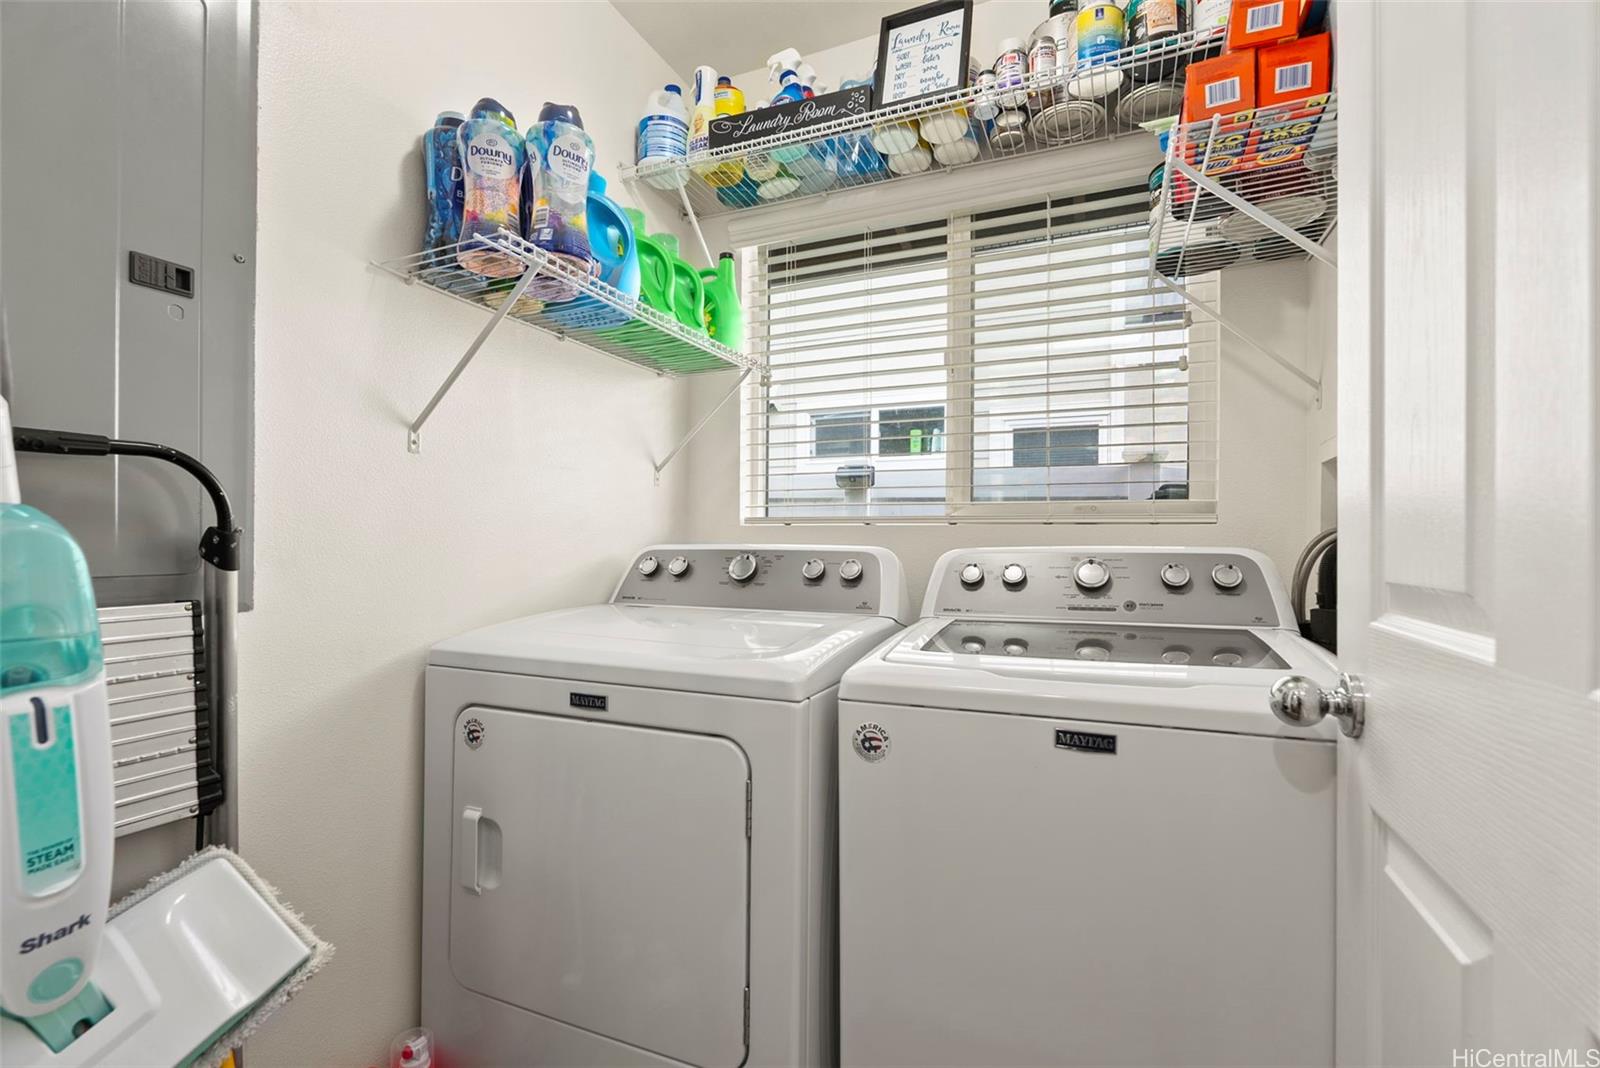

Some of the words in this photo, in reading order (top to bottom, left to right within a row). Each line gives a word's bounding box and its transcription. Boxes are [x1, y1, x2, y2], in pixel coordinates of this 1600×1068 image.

[891, 28, 931, 49] Laundry
[939, 20, 960, 36] Room
[733, 115, 794, 138] Laundry
[795, 101, 836, 124] Room
[470, 145, 512, 165] Downy
[571, 694, 605, 707] MAYTAG
[856, 723, 889, 743] AMERICA
[1058, 732, 1114, 749] MAYTAG
[26, 843, 75, 869] STEAM
[19, 913, 91, 954] Shark
